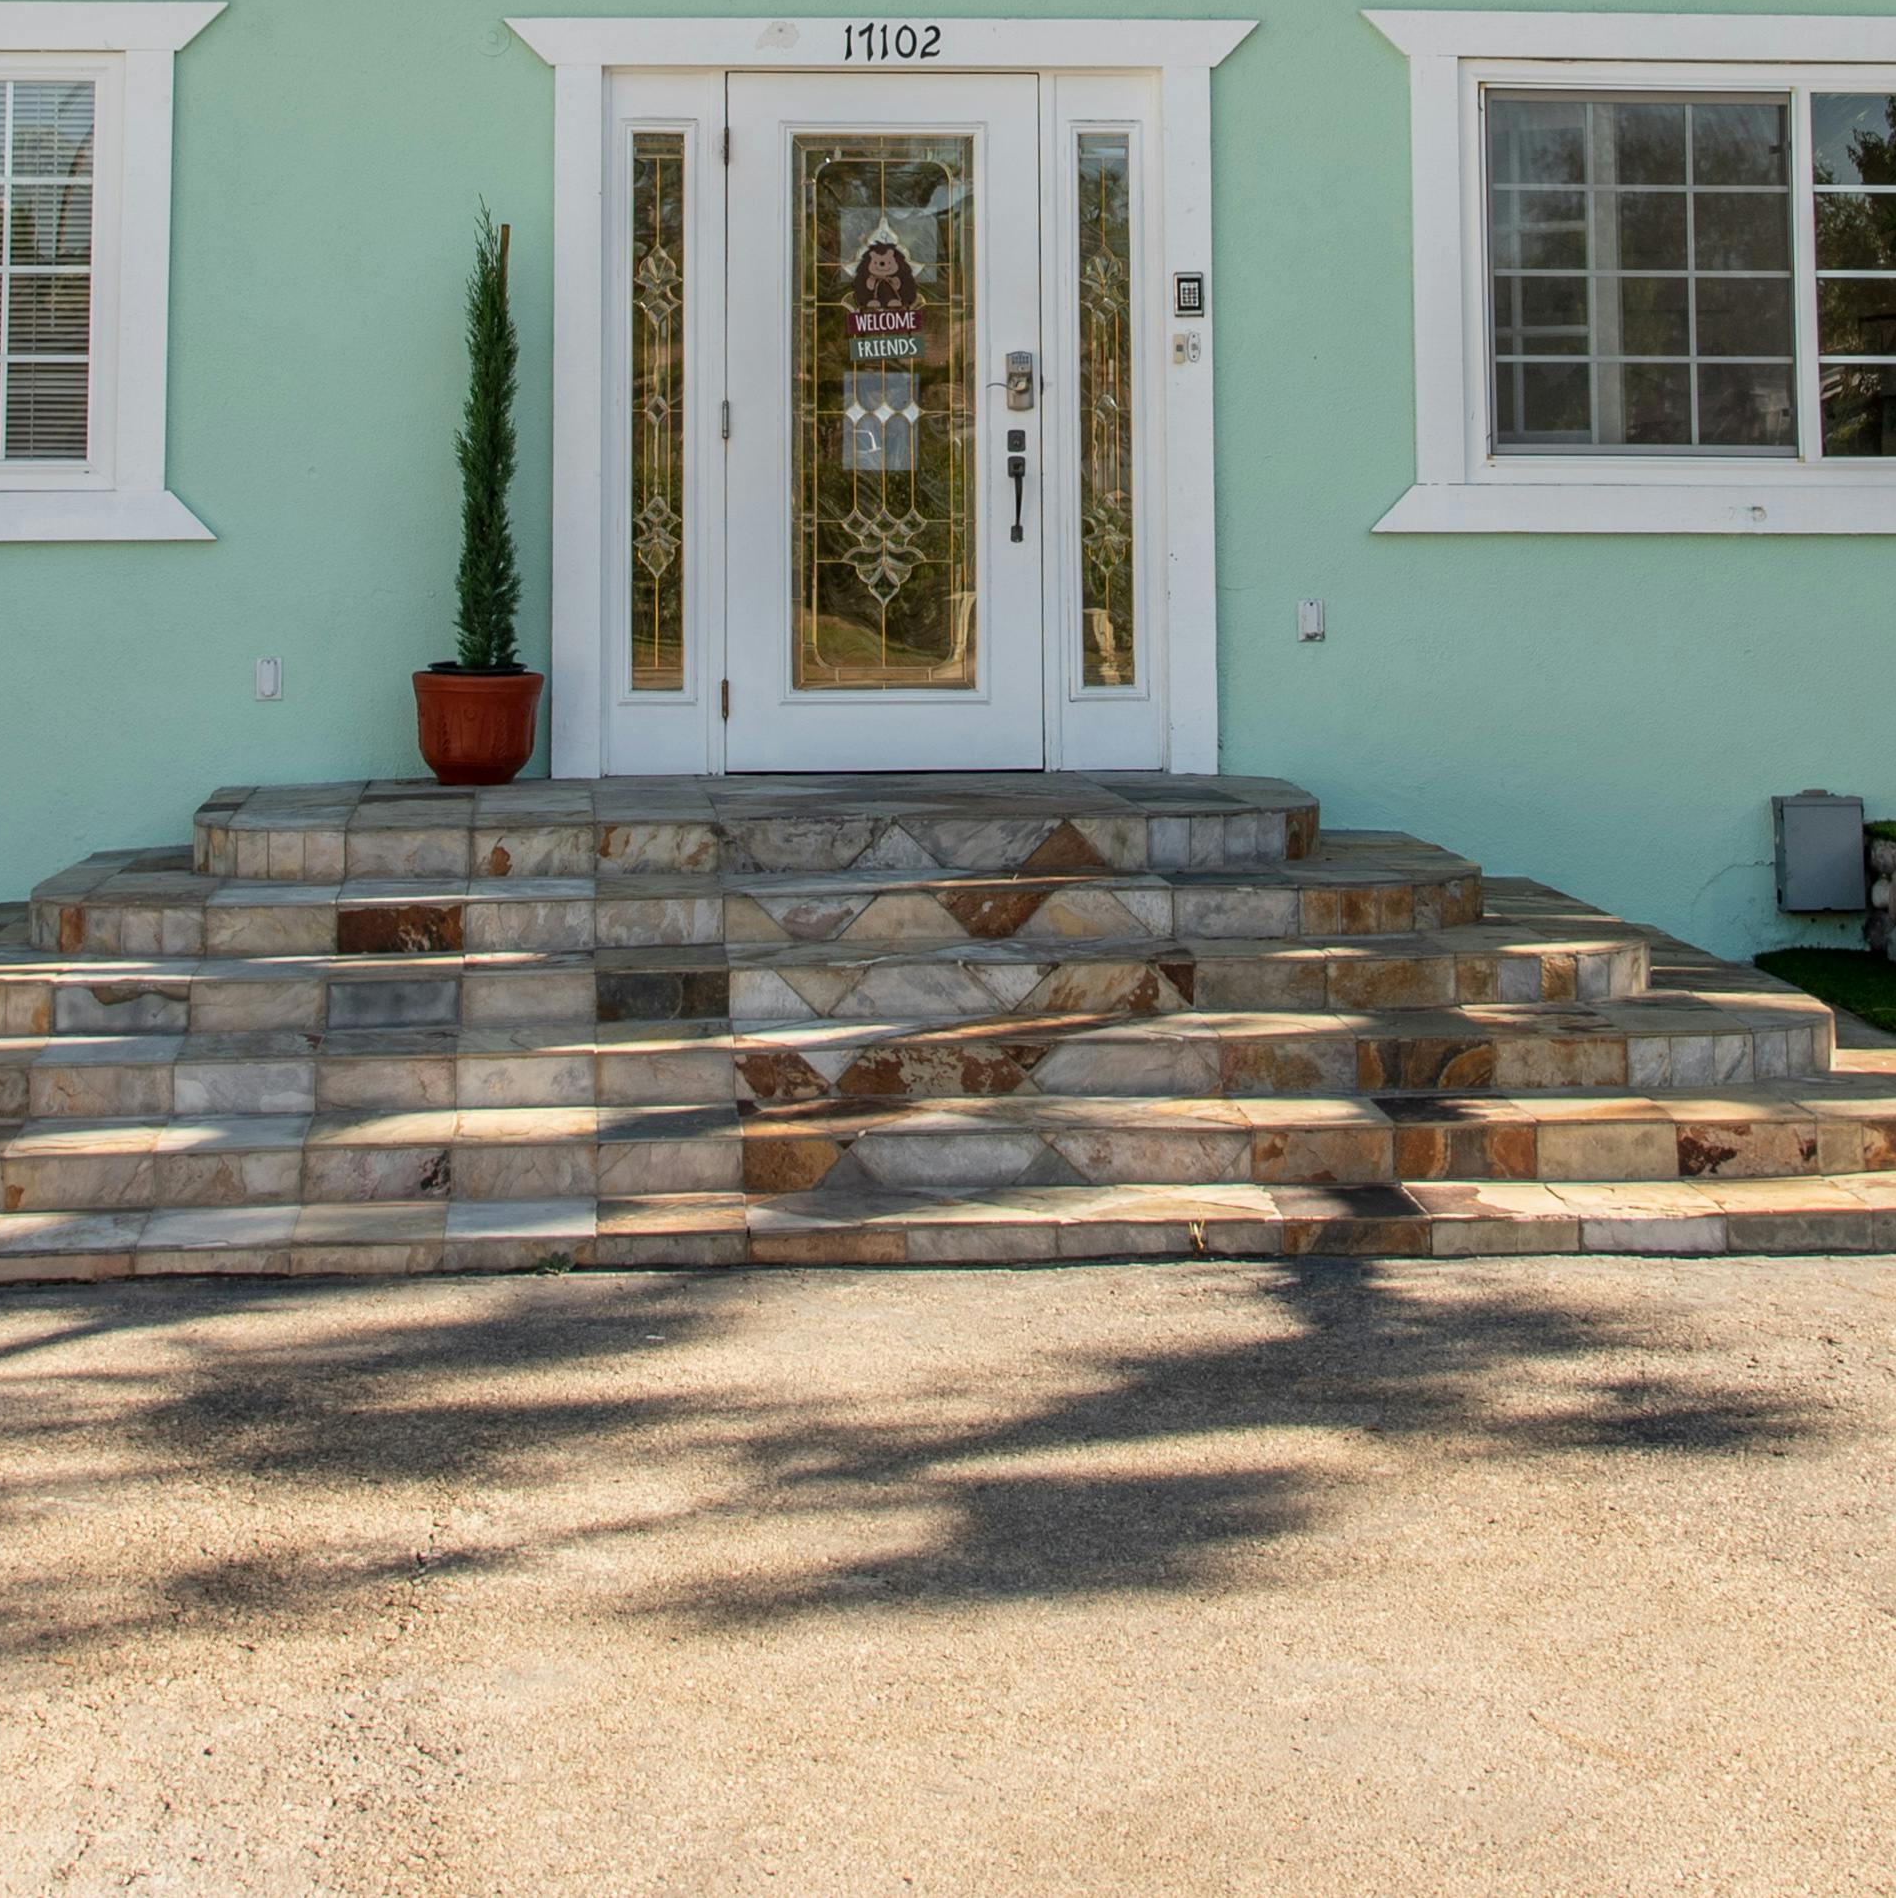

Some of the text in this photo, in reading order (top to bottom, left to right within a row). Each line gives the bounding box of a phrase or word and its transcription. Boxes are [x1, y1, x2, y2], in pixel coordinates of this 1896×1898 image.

[844, 23, 941, 61] 17102
[855, 311, 917, 332] WELCOME
[857, 337, 918, 358] FRIENDS
